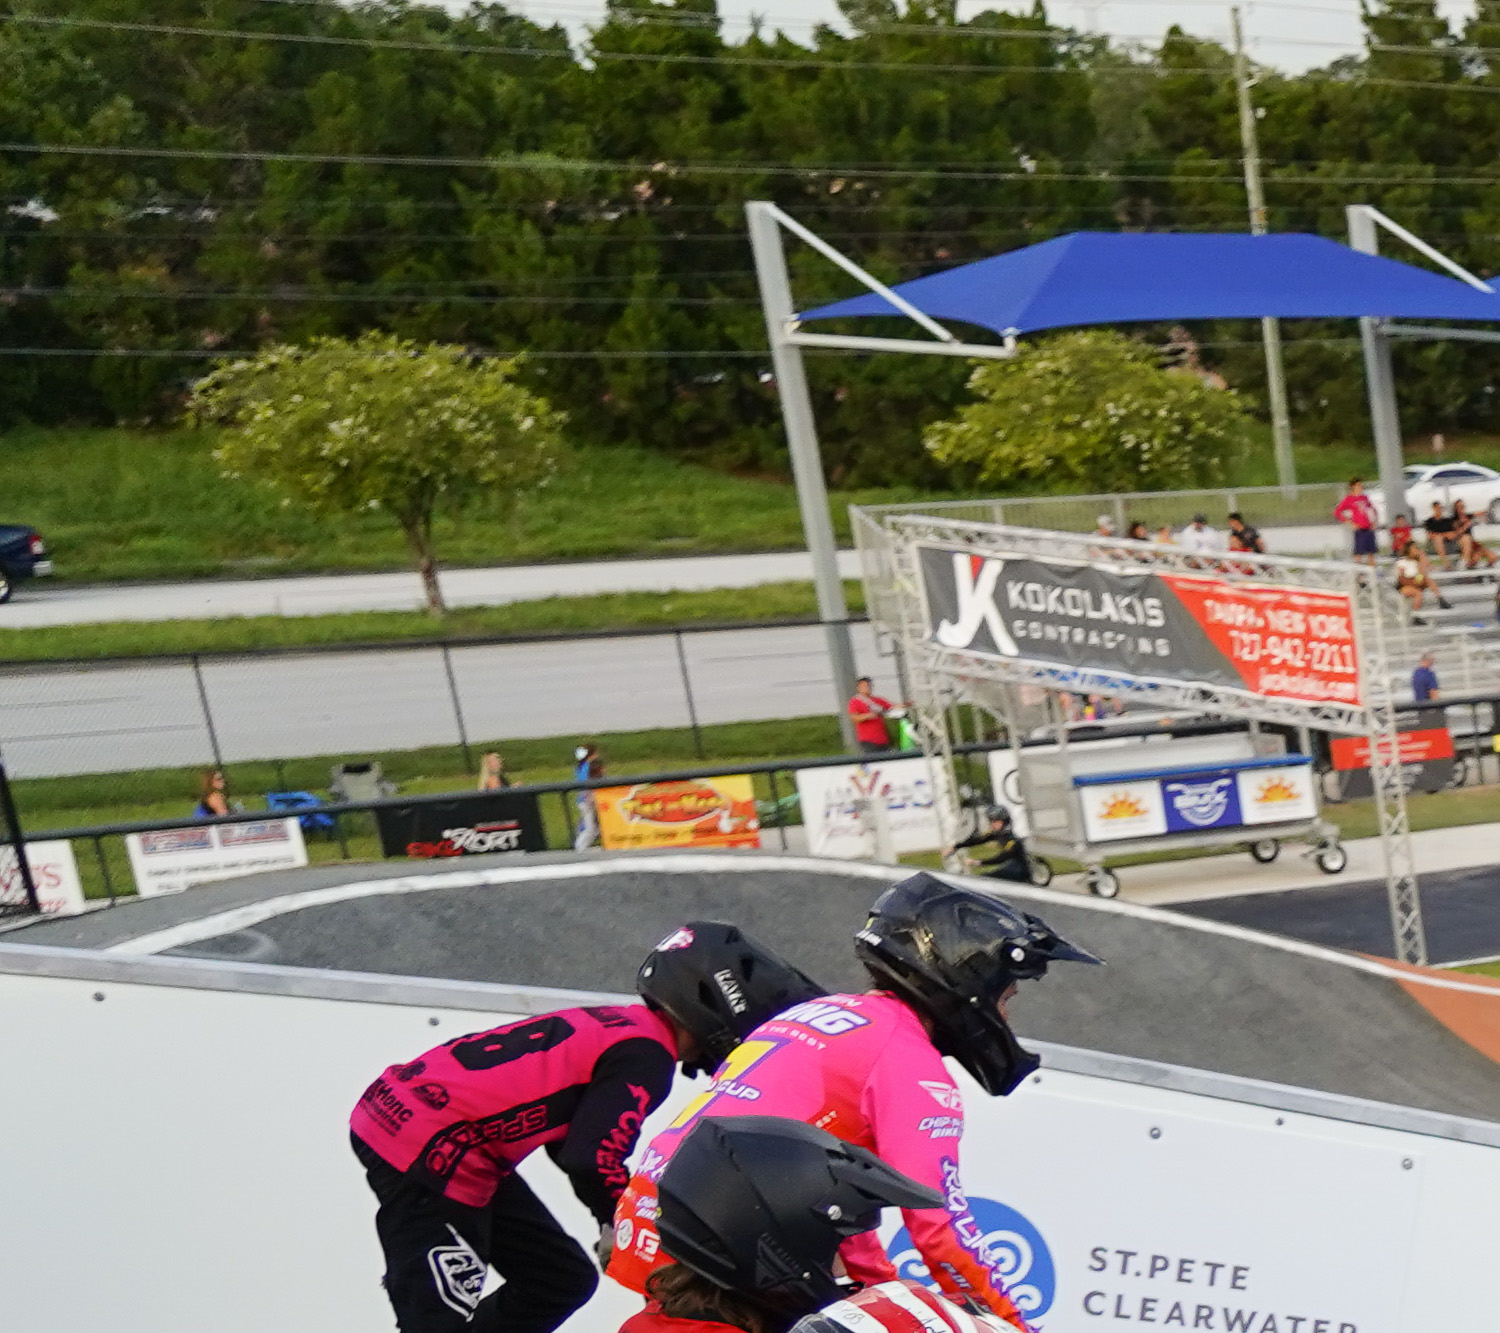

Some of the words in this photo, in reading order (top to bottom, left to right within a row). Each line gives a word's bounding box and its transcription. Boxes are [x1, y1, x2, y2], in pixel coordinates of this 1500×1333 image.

[1006, 580, 1165, 627] KOKOLAKIS
[1013, 620, 1171, 657] CONTRACTING
[1088, 1244, 1252, 1292] ST.PETE
